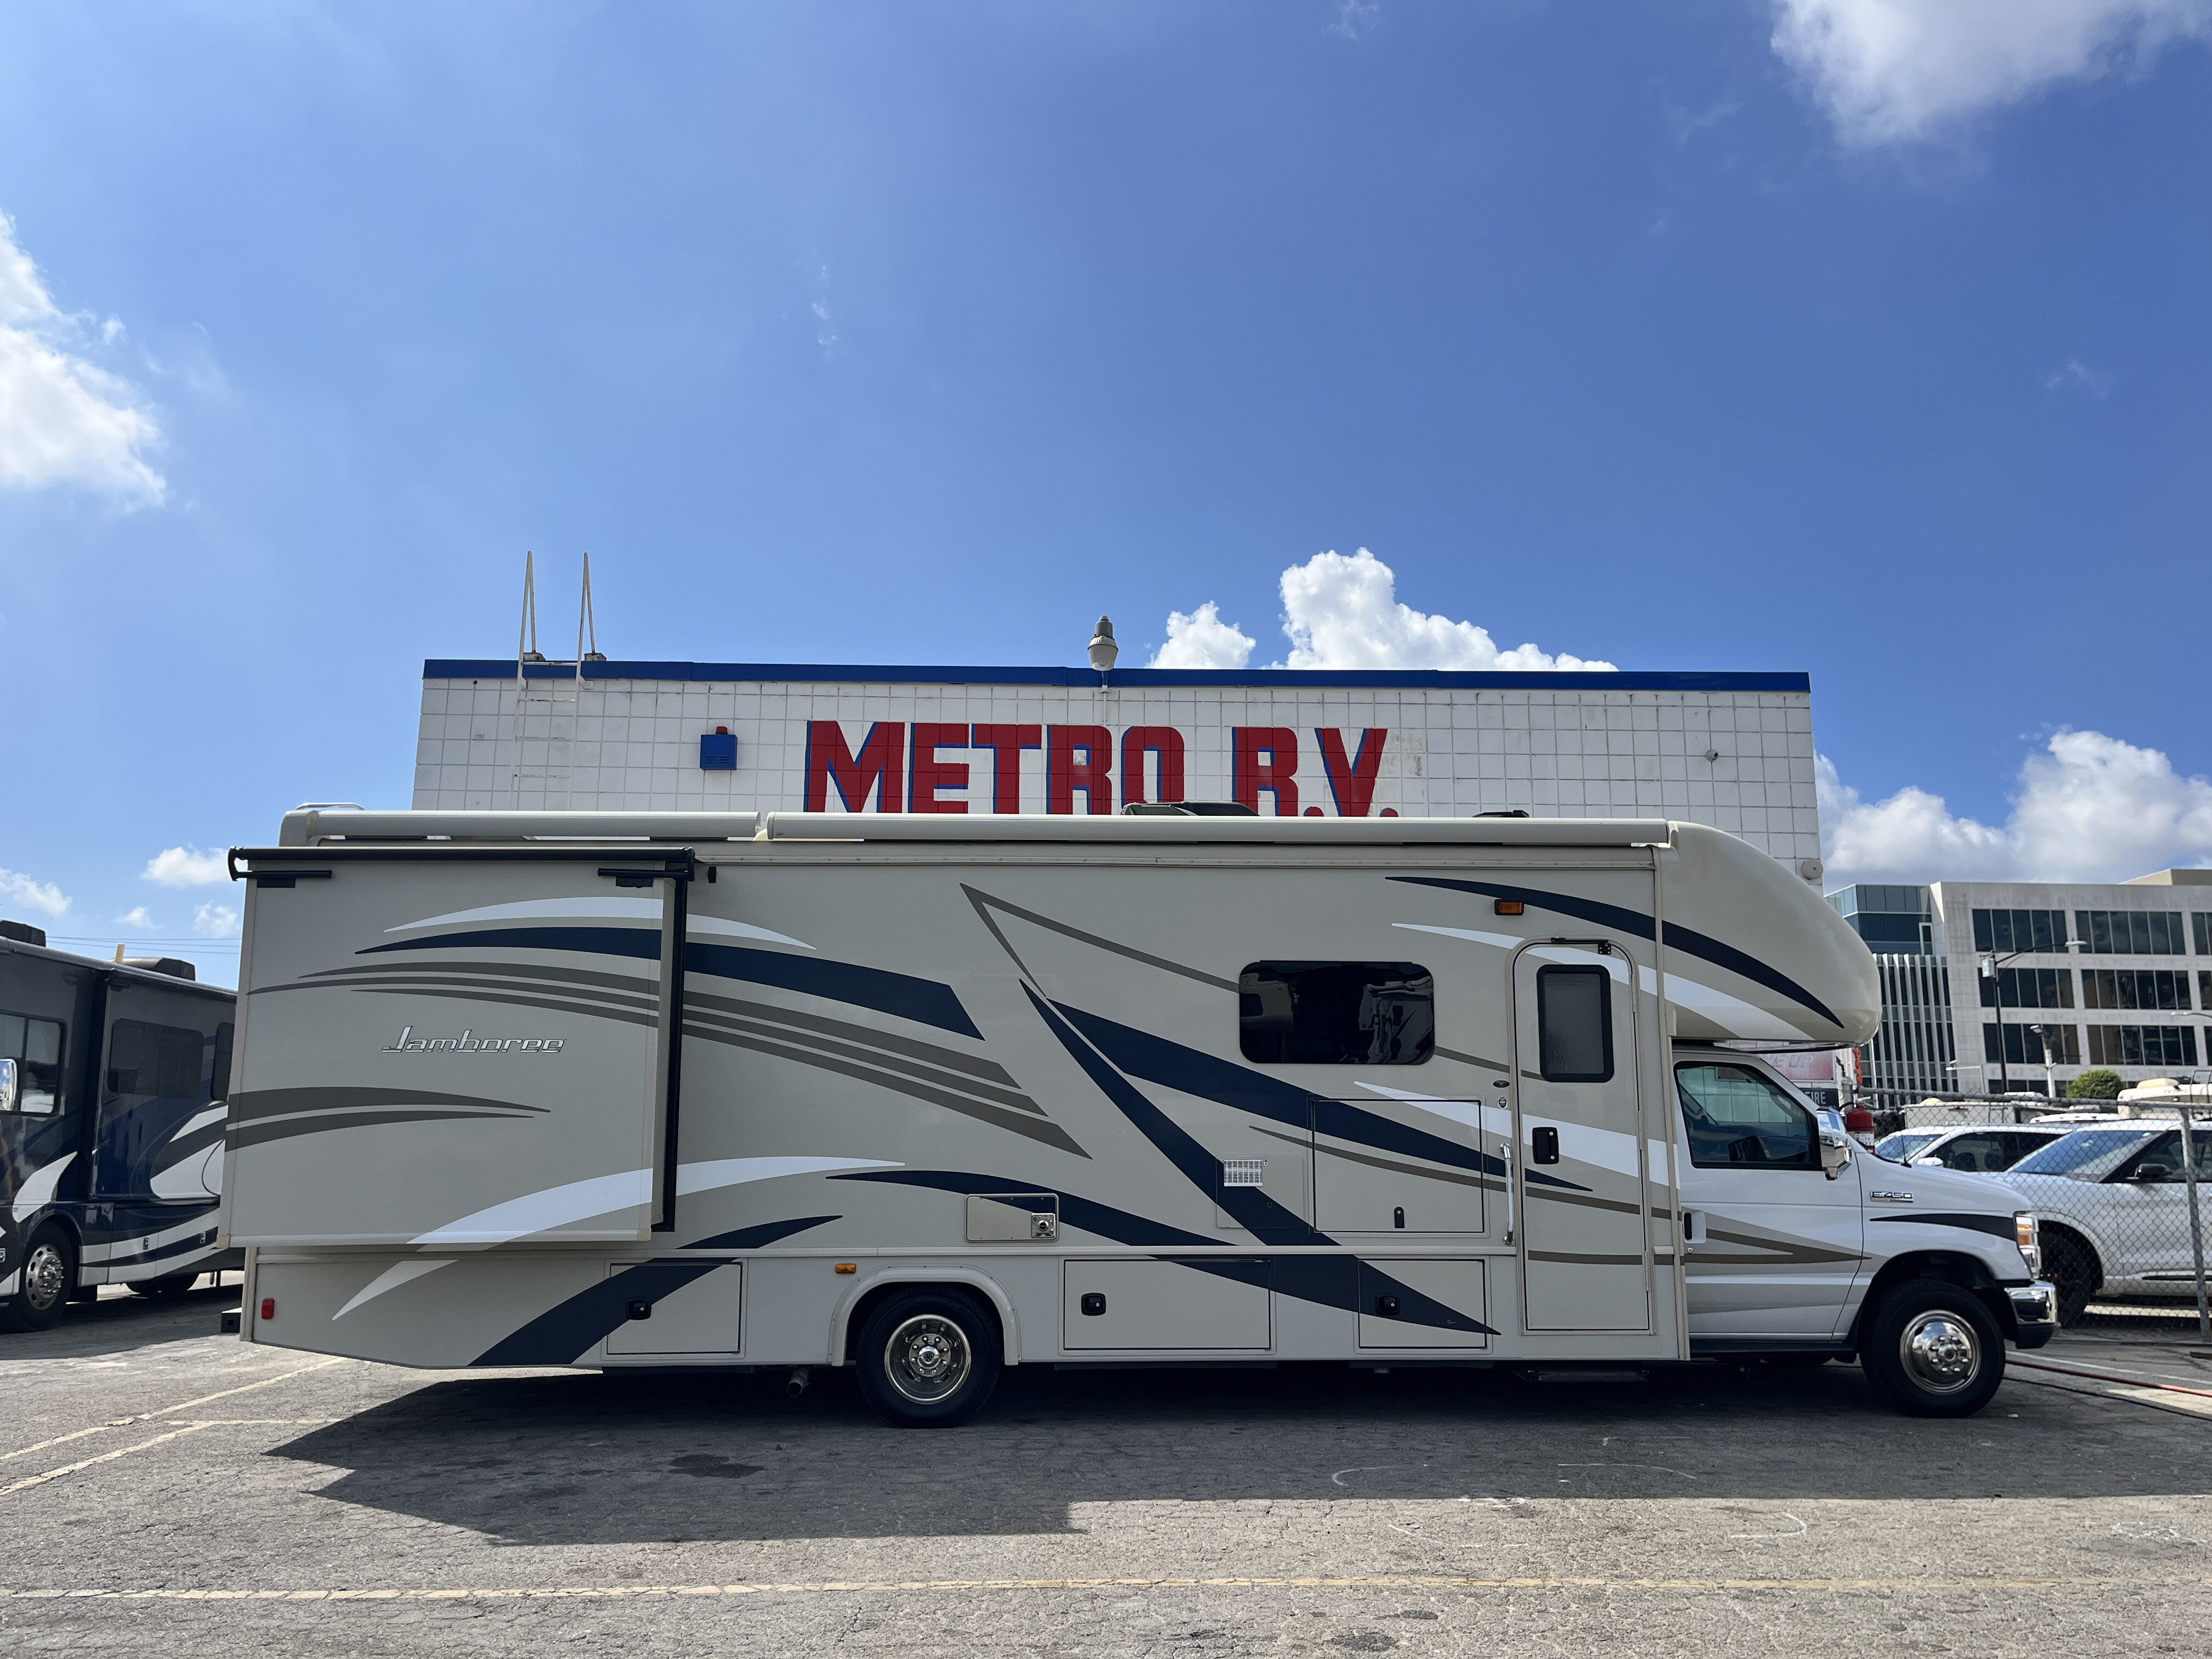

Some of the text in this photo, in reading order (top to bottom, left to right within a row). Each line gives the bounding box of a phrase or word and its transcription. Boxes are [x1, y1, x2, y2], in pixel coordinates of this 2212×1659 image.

[803, 720, 1398, 817] METRO R.V.
[382, 1025, 563, 1053] Jamboree
[1871, 1190, 1913, 1199] E-450
